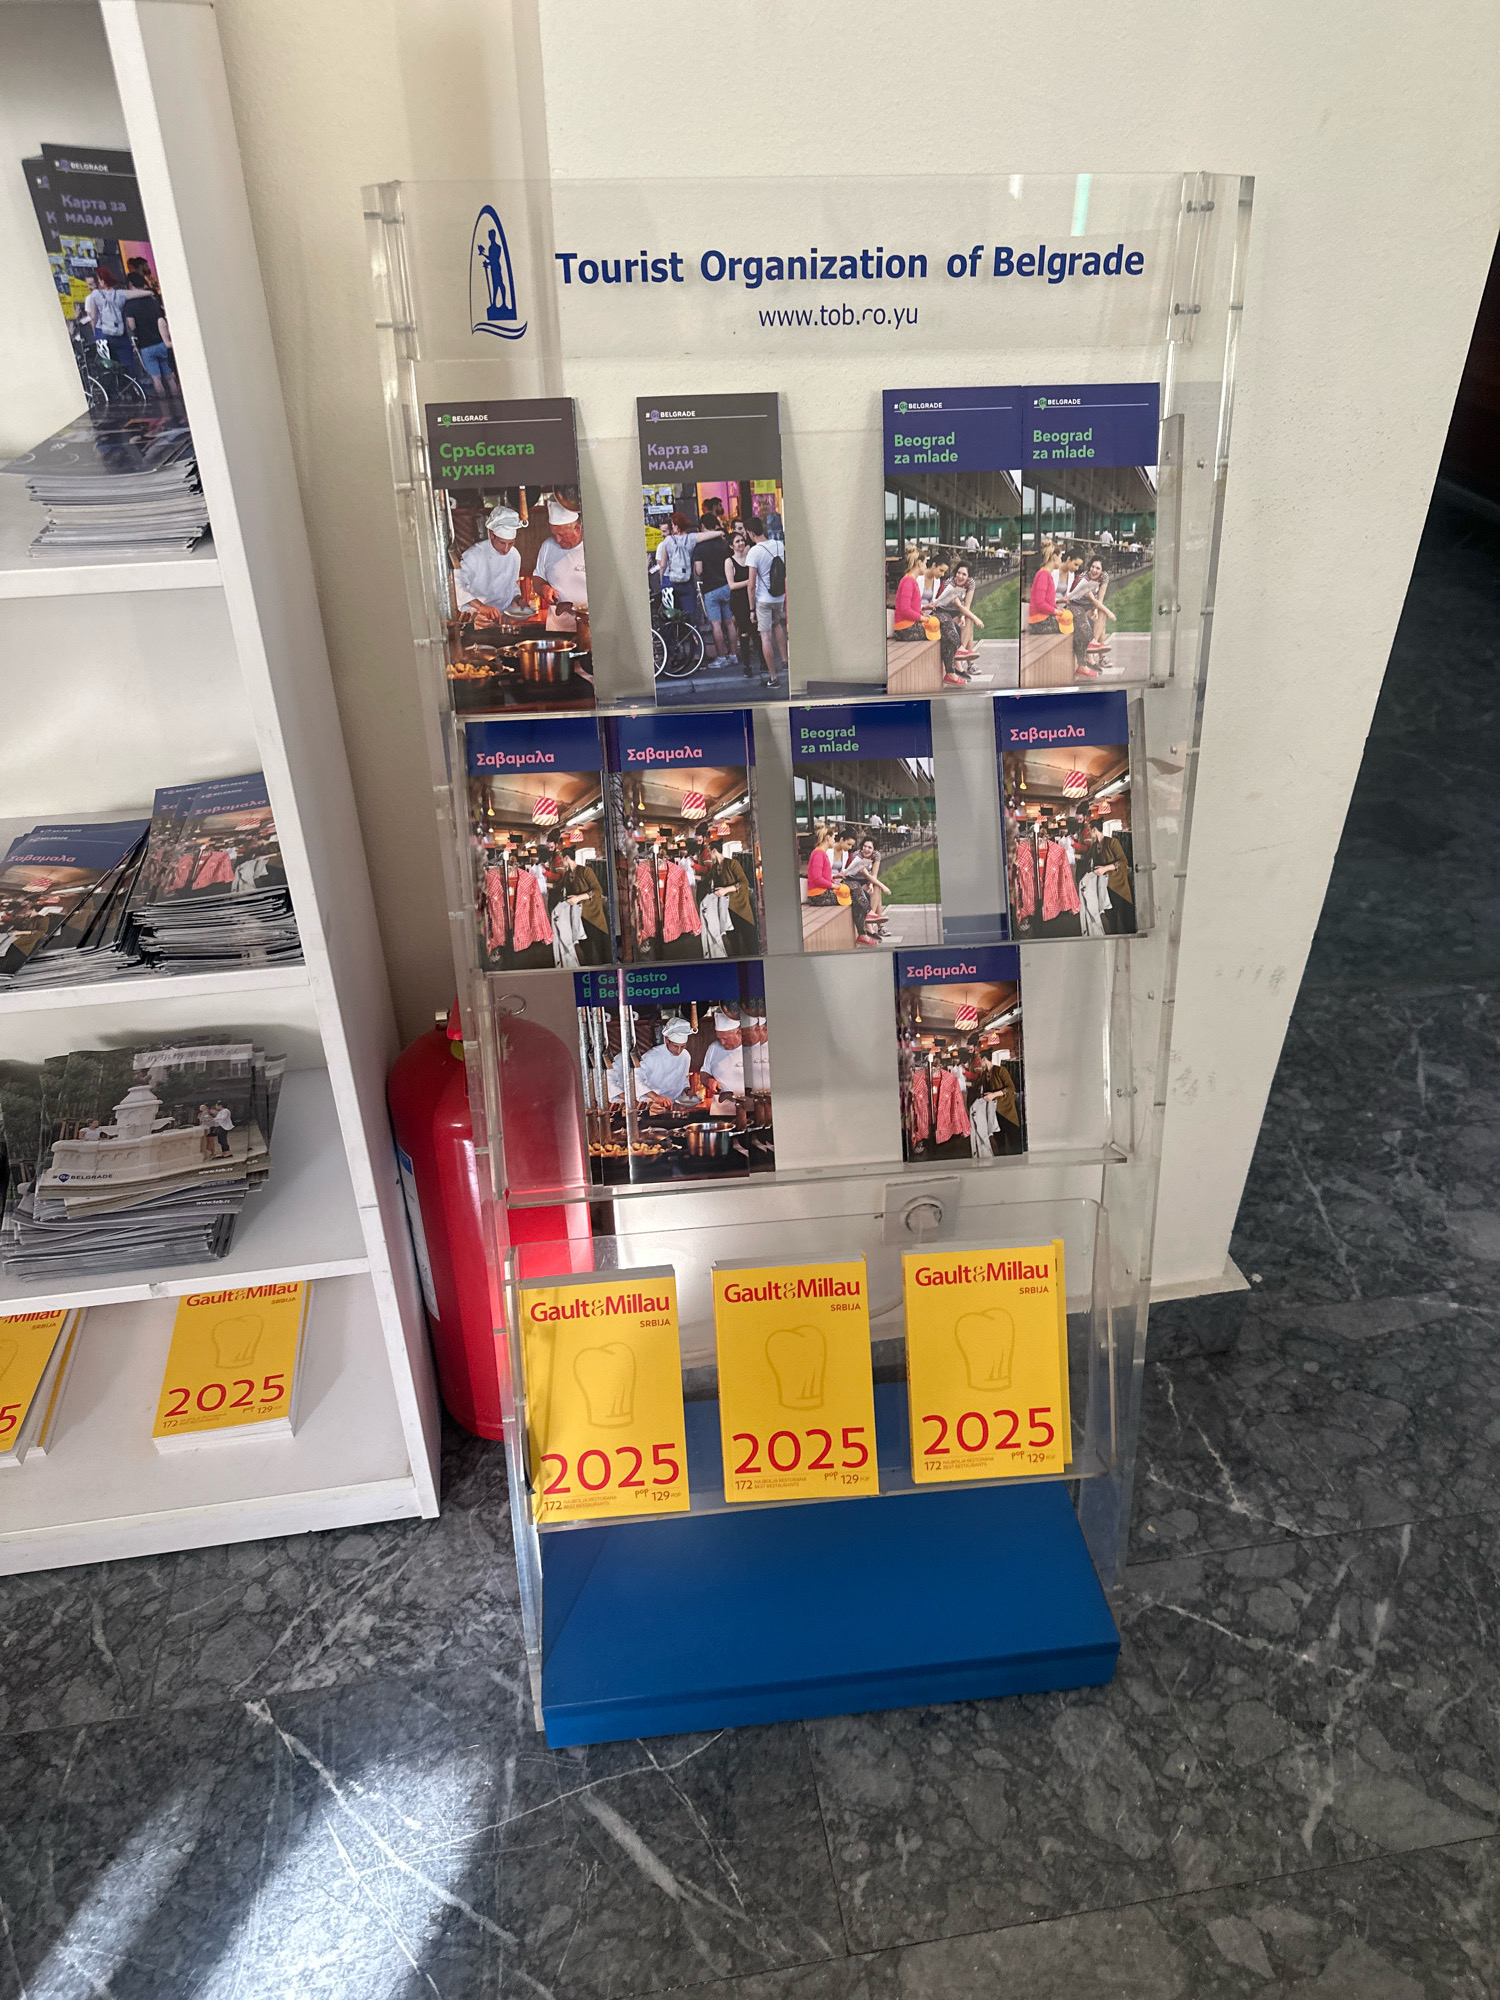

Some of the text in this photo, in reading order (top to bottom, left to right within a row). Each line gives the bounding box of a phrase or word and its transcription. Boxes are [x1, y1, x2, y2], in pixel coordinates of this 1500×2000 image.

[61, 193, 127, 212] Карта за
[65, 213, 113, 227] млади
[555, 244, 1145, 289] Tourist Organization of Belgrade
[894, 431, 955, 450] Beograd
[1033, 427, 1093, 445] Beograd
[439, 441, 535, 462] Сръбската
[647, 443, 709, 459] Карта за
[894, 448, 959, 464] za mlade
[1032, 444, 1095, 459] za mlade
[441, 464, 496, 481] кухня
[648, 460, 694, 472] млади
[800, 725, 856, 740] Beograd
[1010, 724, 1086, 743] Σαβαμαλα
[627, 745, 703, 763] Σαβαμαλα
[801, 739, 860, 754] za mlade
[476, 750, 555, 768] Σαβαμαλα
[194, 800, 266, 815] Σαβαμαλα
[7, 854, 76, 863] Σαβαμαλα
[625, 972, 668, 984] Gastro
[906, 963, 977, 980] Σαβαμαλα
[626, 983, 680, 999] Beograd
[915, 1261, 1049, 1287] Gault&Millau
[186, 1283, 298, 1307] Gault&Millau
[724, 1277, 861, 1304] Gault&Millau
[1019, 1286, 1049, 1295] SRBIJA
[530, 1292, 670, 1323] Gault&Millau
[830, 1303, 861, 1312] SRBIJA
[639, 1319, 671, 1328] SRBIJA
[164, 1373, 285, 1418] 2025
[257, 1405, 273, 1415] 129
[163, 1420, 178, 1429] 172
[922, 1406, 1055, 1456] 2025
[732, 1427, 869, 1475] 2025
[1027, 1453, 1045, 1463] 129
[540, 1443, 680, 1496] 2025
[924, 1461, 942, 1471] 172
[735, 1479, 753, 1490] 172
[841, 1473, 859, 1485] 129
[652, 1490, 670, 1502] 129
[544, 1500, 562, 1511] 172
